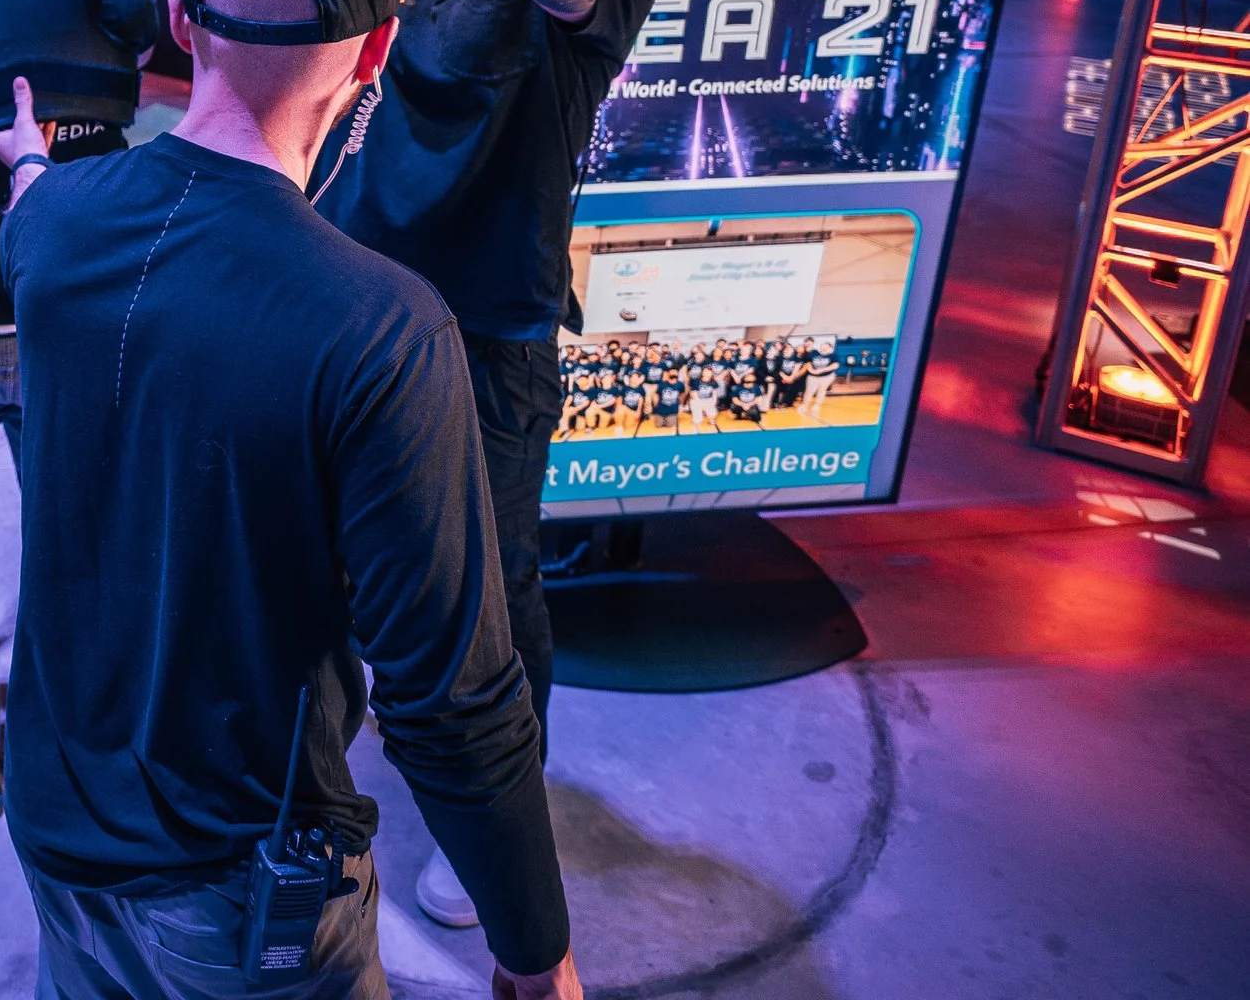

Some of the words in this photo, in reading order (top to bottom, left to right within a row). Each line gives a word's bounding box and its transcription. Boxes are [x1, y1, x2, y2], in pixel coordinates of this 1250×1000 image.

[622, 79, 676, 99] World
[688, 75, 788, 96] Connected
[789, 73, 875, 92] Solutions
[57, 122, 105, 142] EDIA
[568, 454, 691, 489] Mayor's
[701, 447, 860, 478] Challenge
